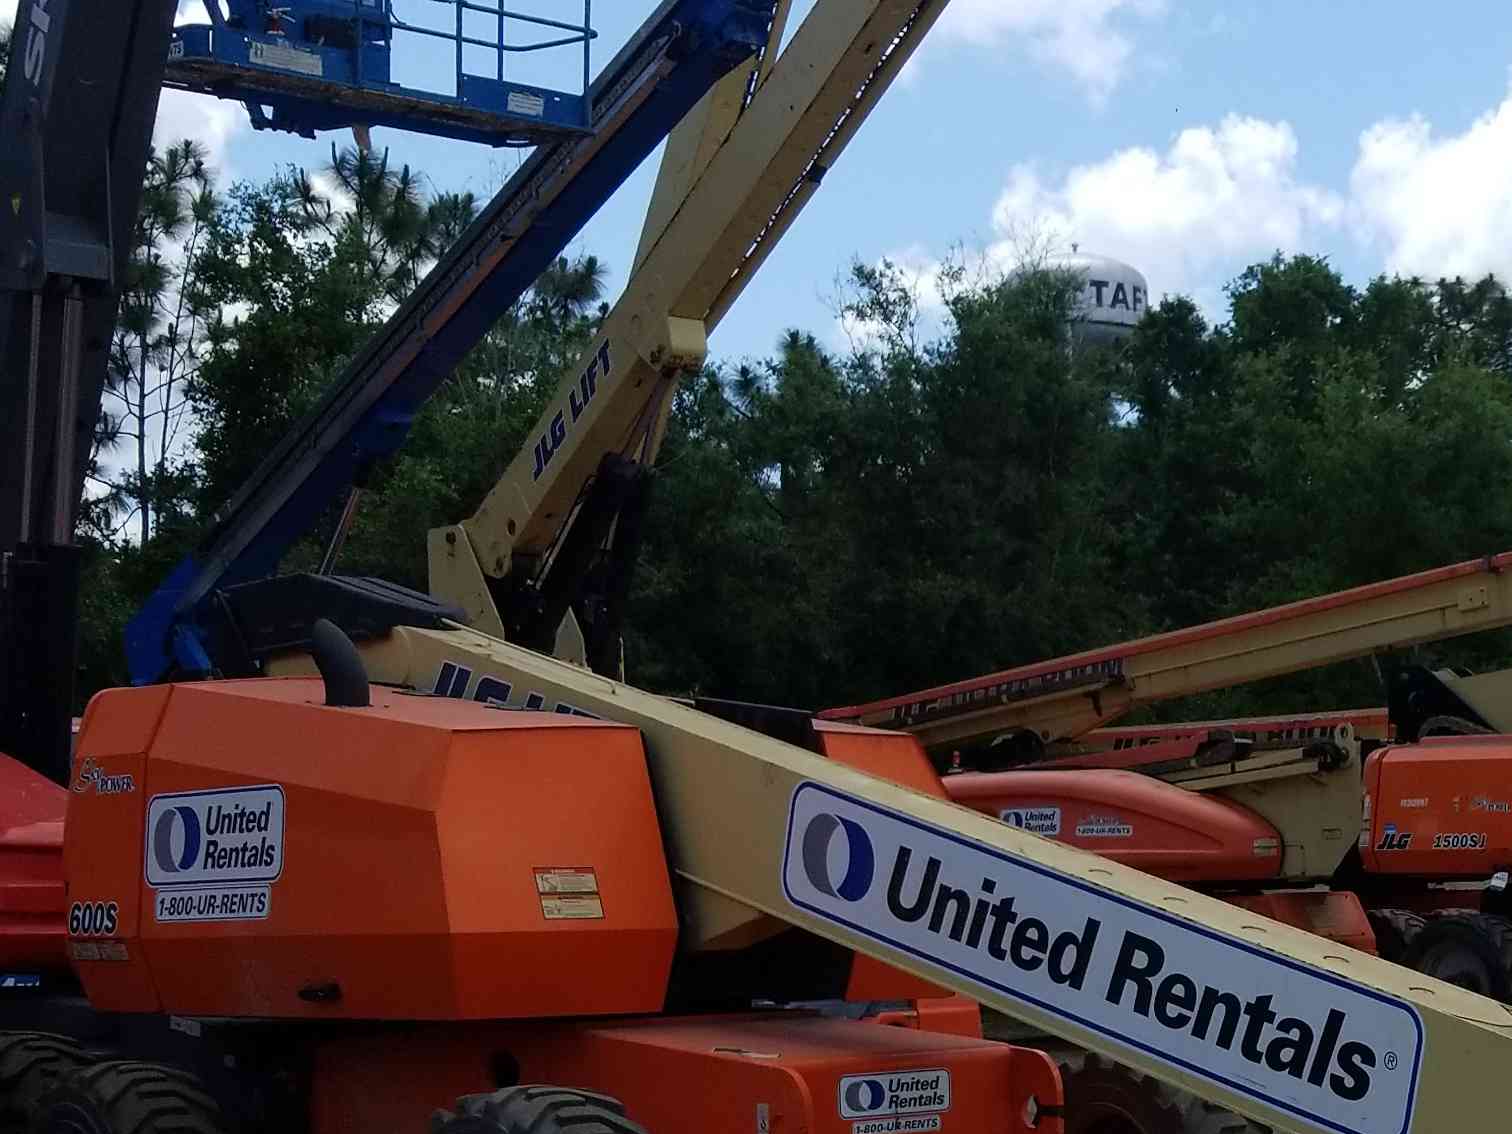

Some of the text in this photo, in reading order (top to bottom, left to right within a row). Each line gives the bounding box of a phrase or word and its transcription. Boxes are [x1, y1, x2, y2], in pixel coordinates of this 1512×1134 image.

[534, 338, 609, 481] JLG LIFT
[205, 801, 272, 835] United
[1024, 811, 1057, 822] United
[1024, 820, 1058, 833] Rentals
[1377, 832, 1487, 850] JLG 1500SJ
[203, 837, 276, 870] Rentals
[159, 892, 267, 917] 1-800-UR-RENTS
[70, 902, 118, 935] 600S
[886, 845, 1377, 1101] United Rentals
[888, 1076, 940, 1093] United
[888, 1092, 945, 1110] Rentals
[856, 1118, 938, 1134] 1-800-UR-RENTS
